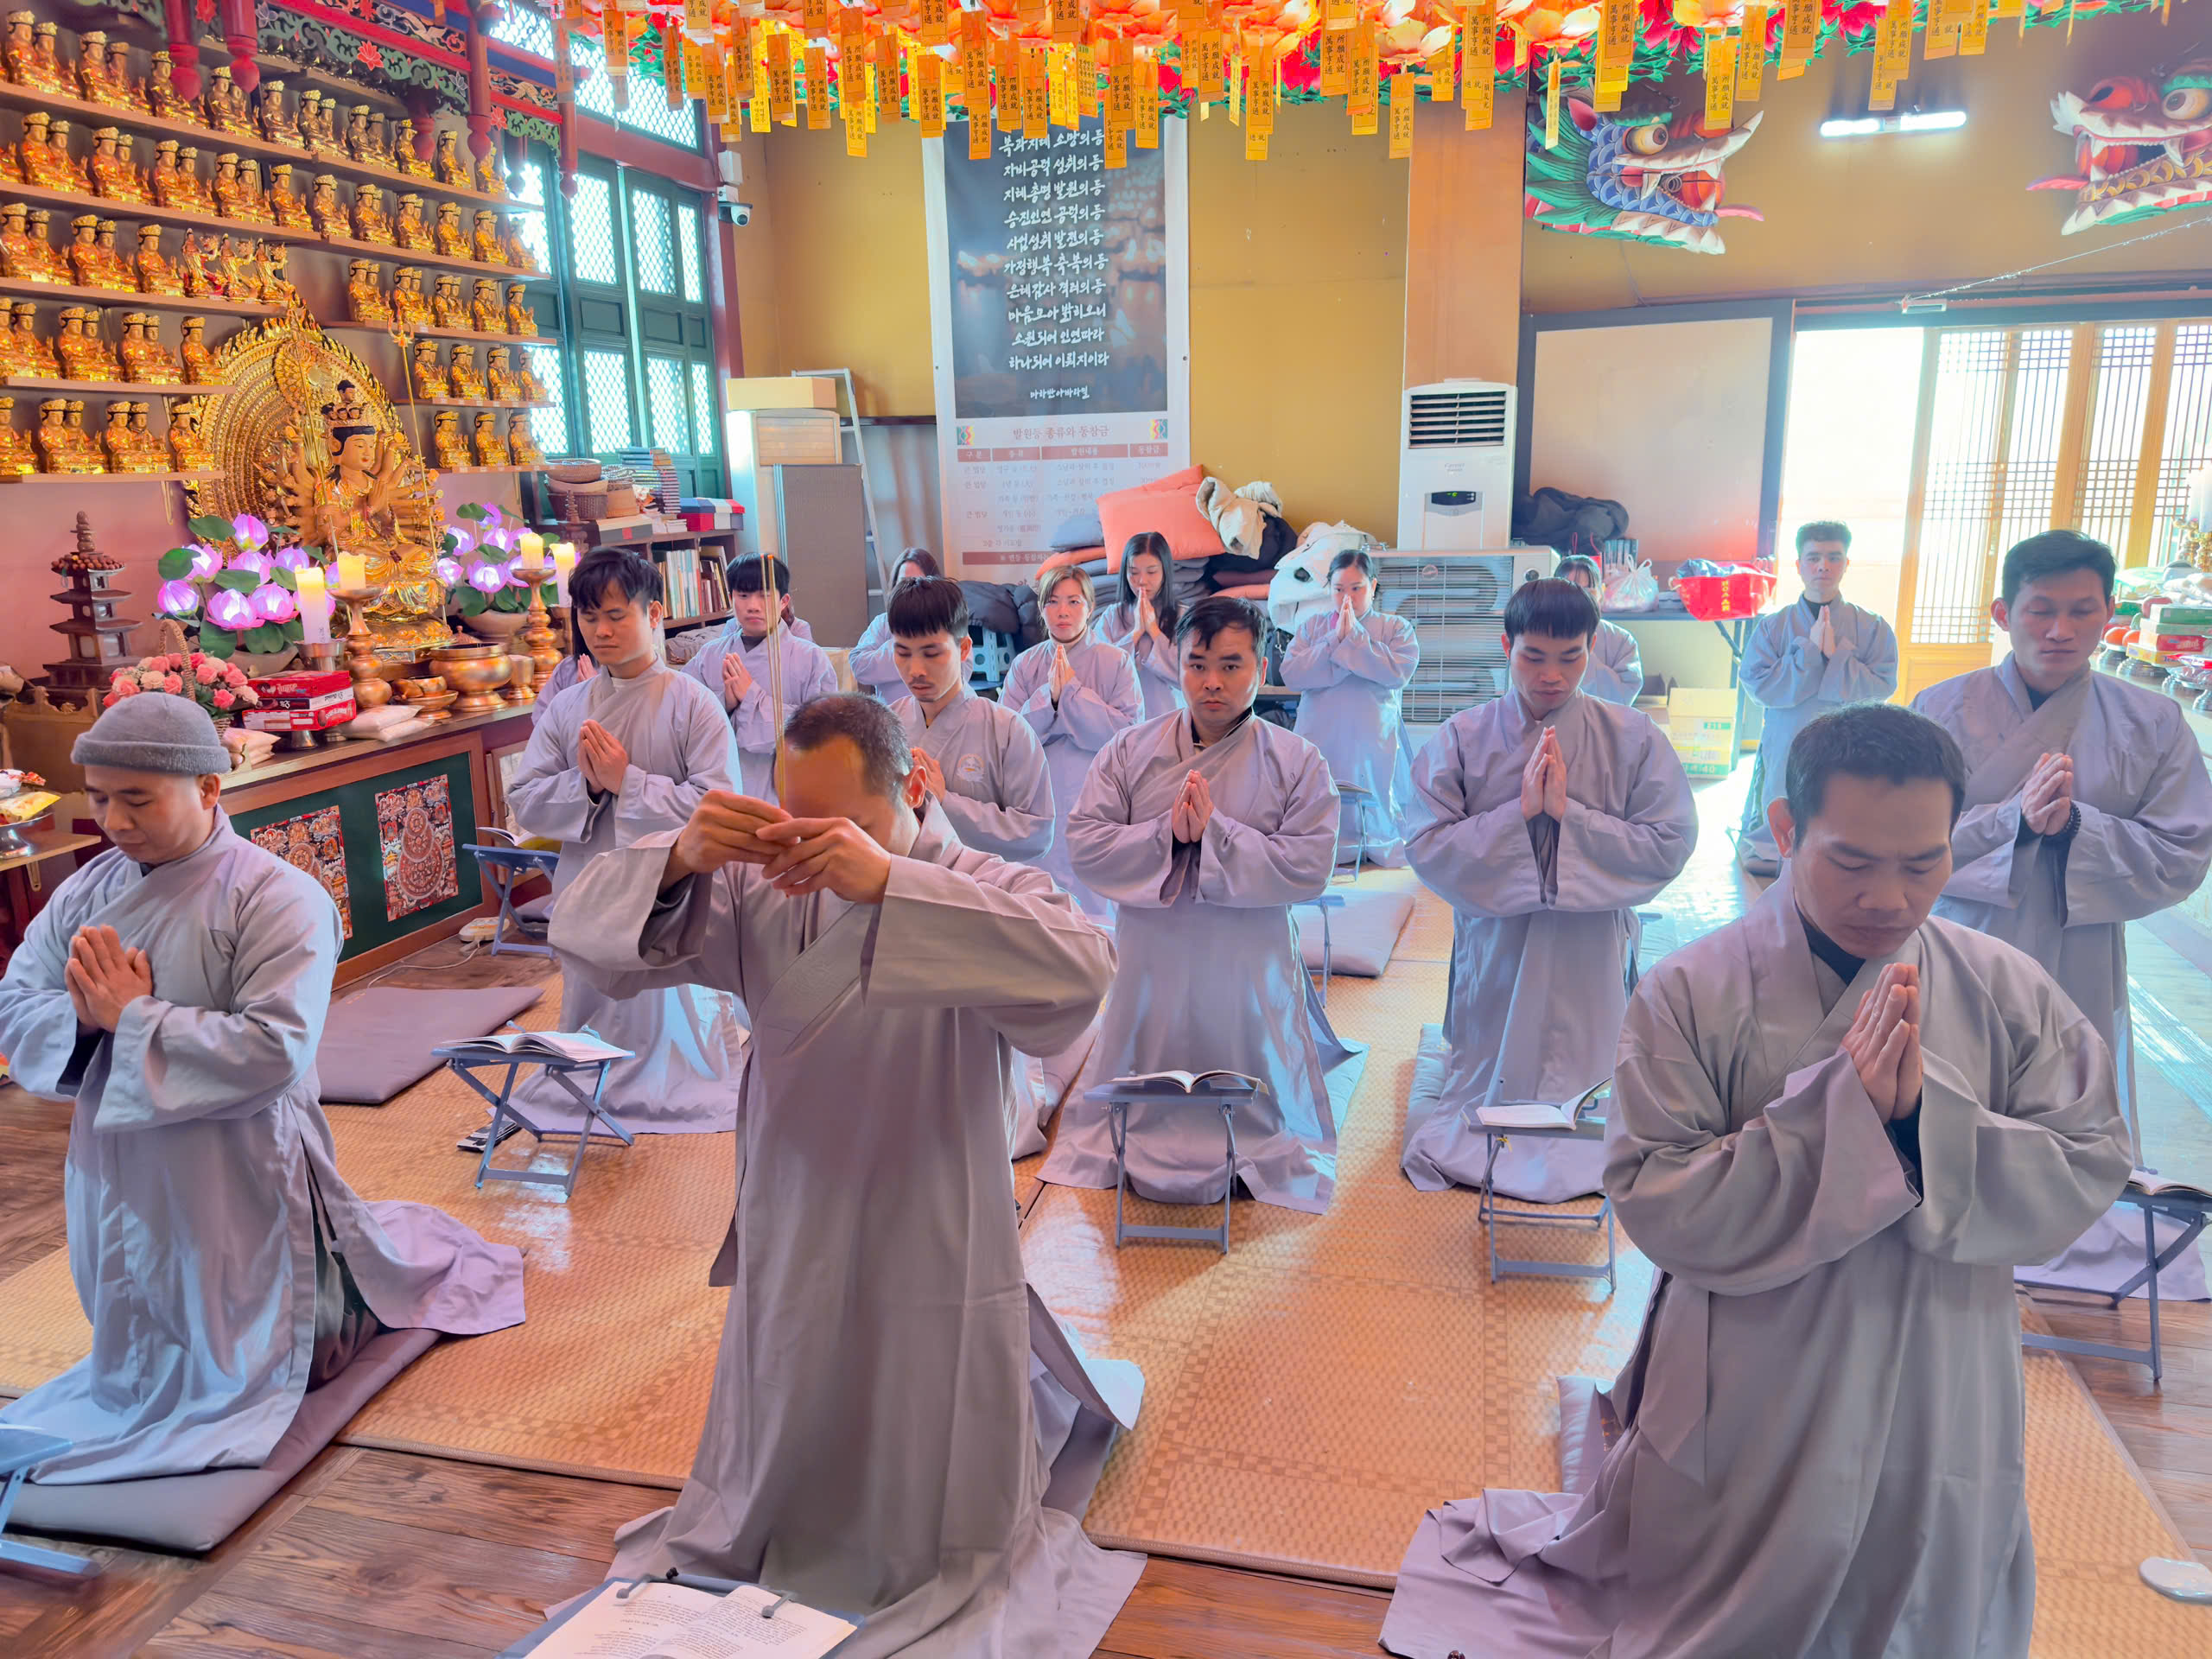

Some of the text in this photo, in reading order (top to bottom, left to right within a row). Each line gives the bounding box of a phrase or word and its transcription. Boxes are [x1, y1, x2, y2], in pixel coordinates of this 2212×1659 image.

[924, 0, 932, 24] 亨通
[935, 0, 944, 23] 成就
[1482, 16, 1491, 55] 所願成就
[966, 51, 976, 89] 萬事亨通
[976, 51, 987, 87] 所願成就
